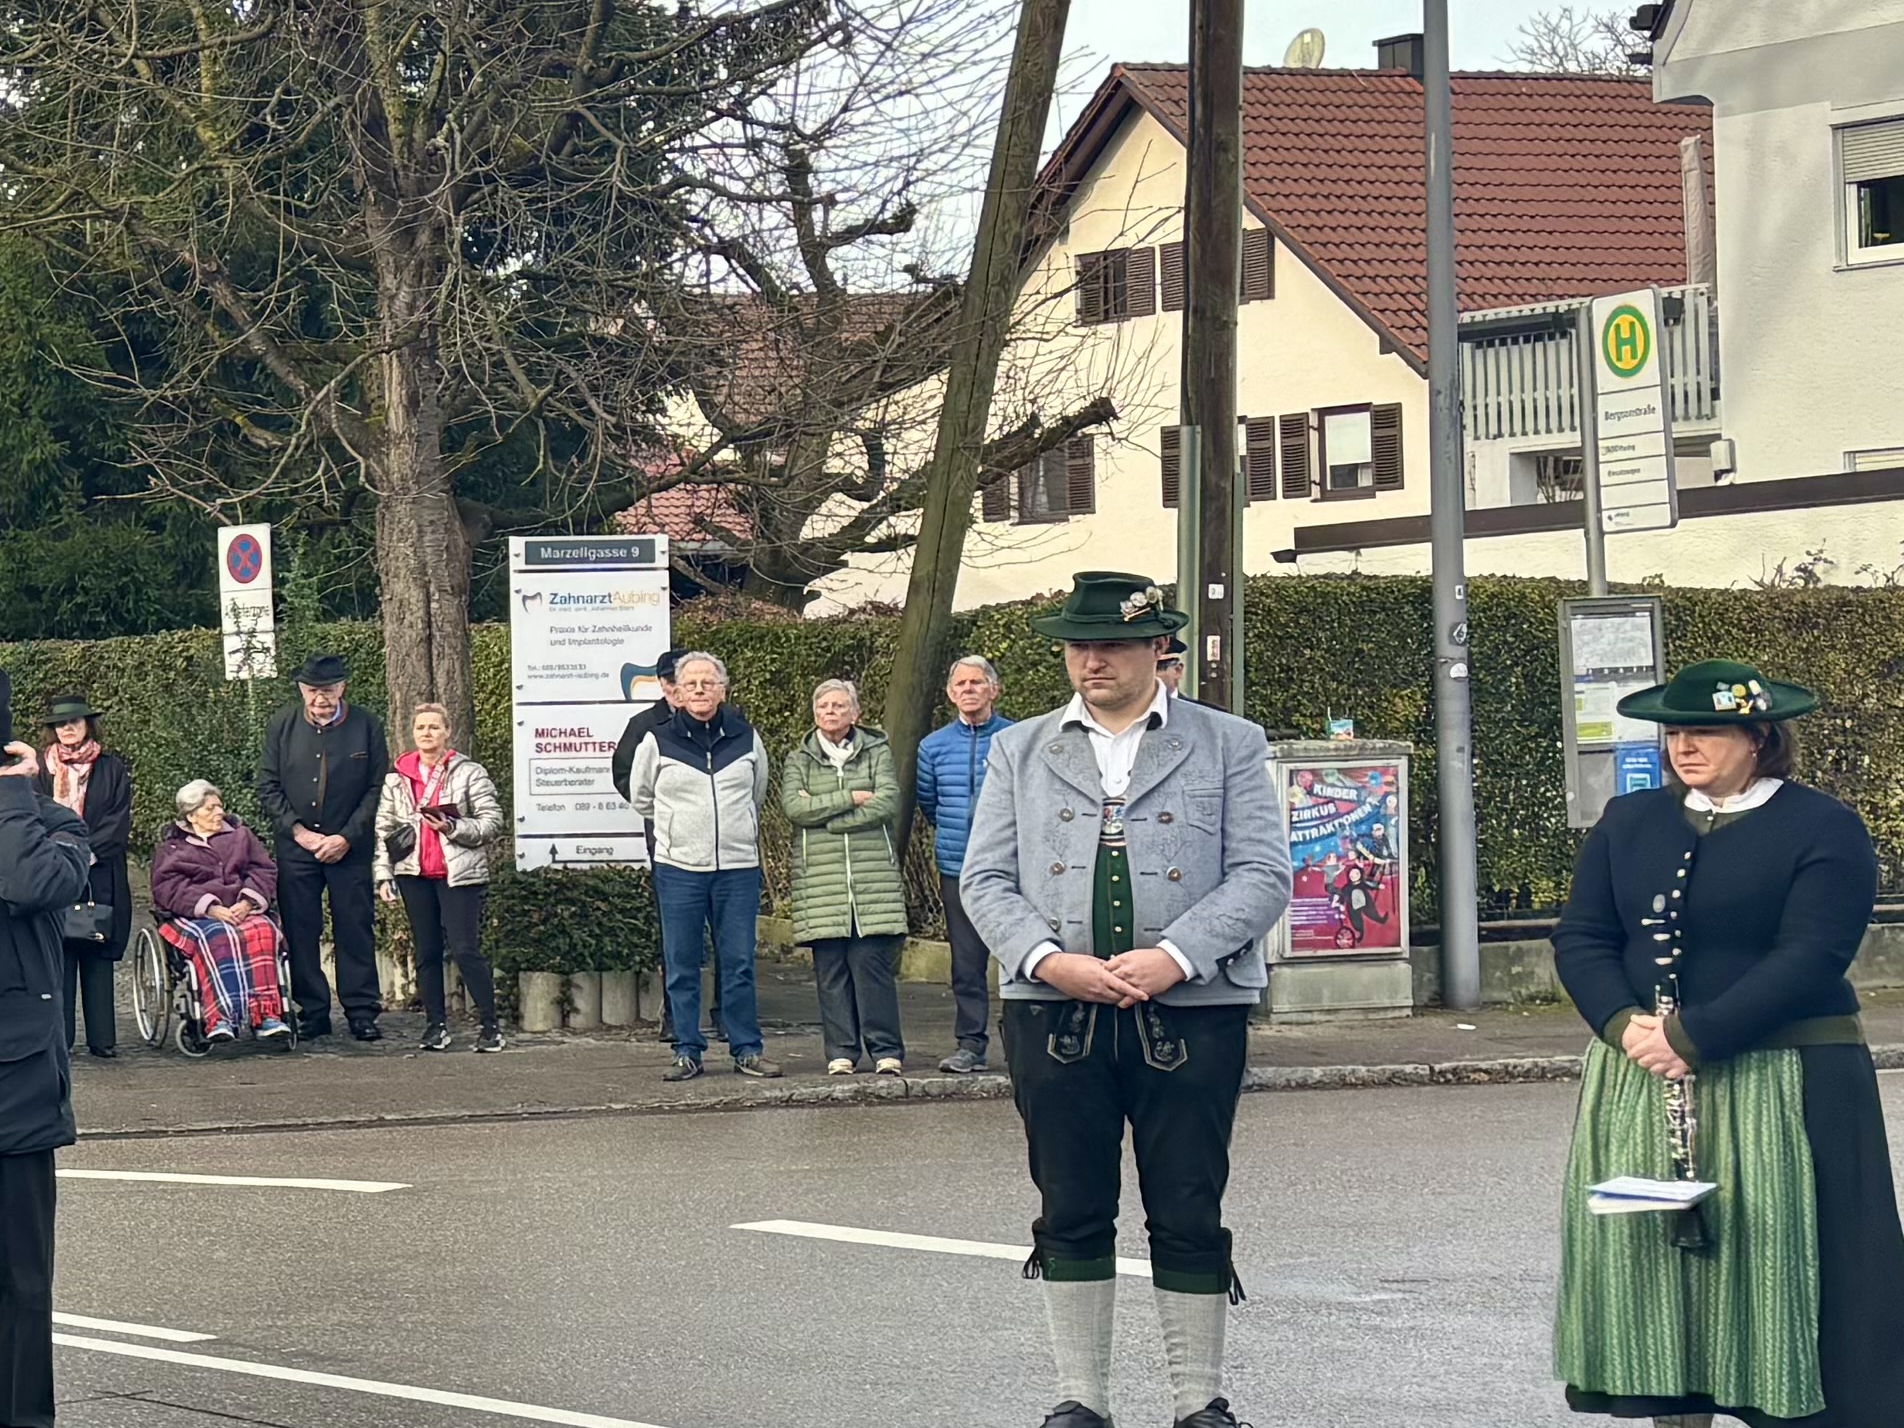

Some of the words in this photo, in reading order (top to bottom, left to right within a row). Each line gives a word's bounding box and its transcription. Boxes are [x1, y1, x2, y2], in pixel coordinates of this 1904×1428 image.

[540, 546, 628, 561] Marzellgasse
[631, 546, 640, 558] 9
[535, 727, 594, 739] MICHAEL
[535, 778, 596, 788] Steuerberater
[1313, 783, 1358, 800] KINDER
[536, 803, 566, 812] Telefon
[1291, 802, 1337, 822] ZIRKUS
[575, 845, 614, 856] Eingang
